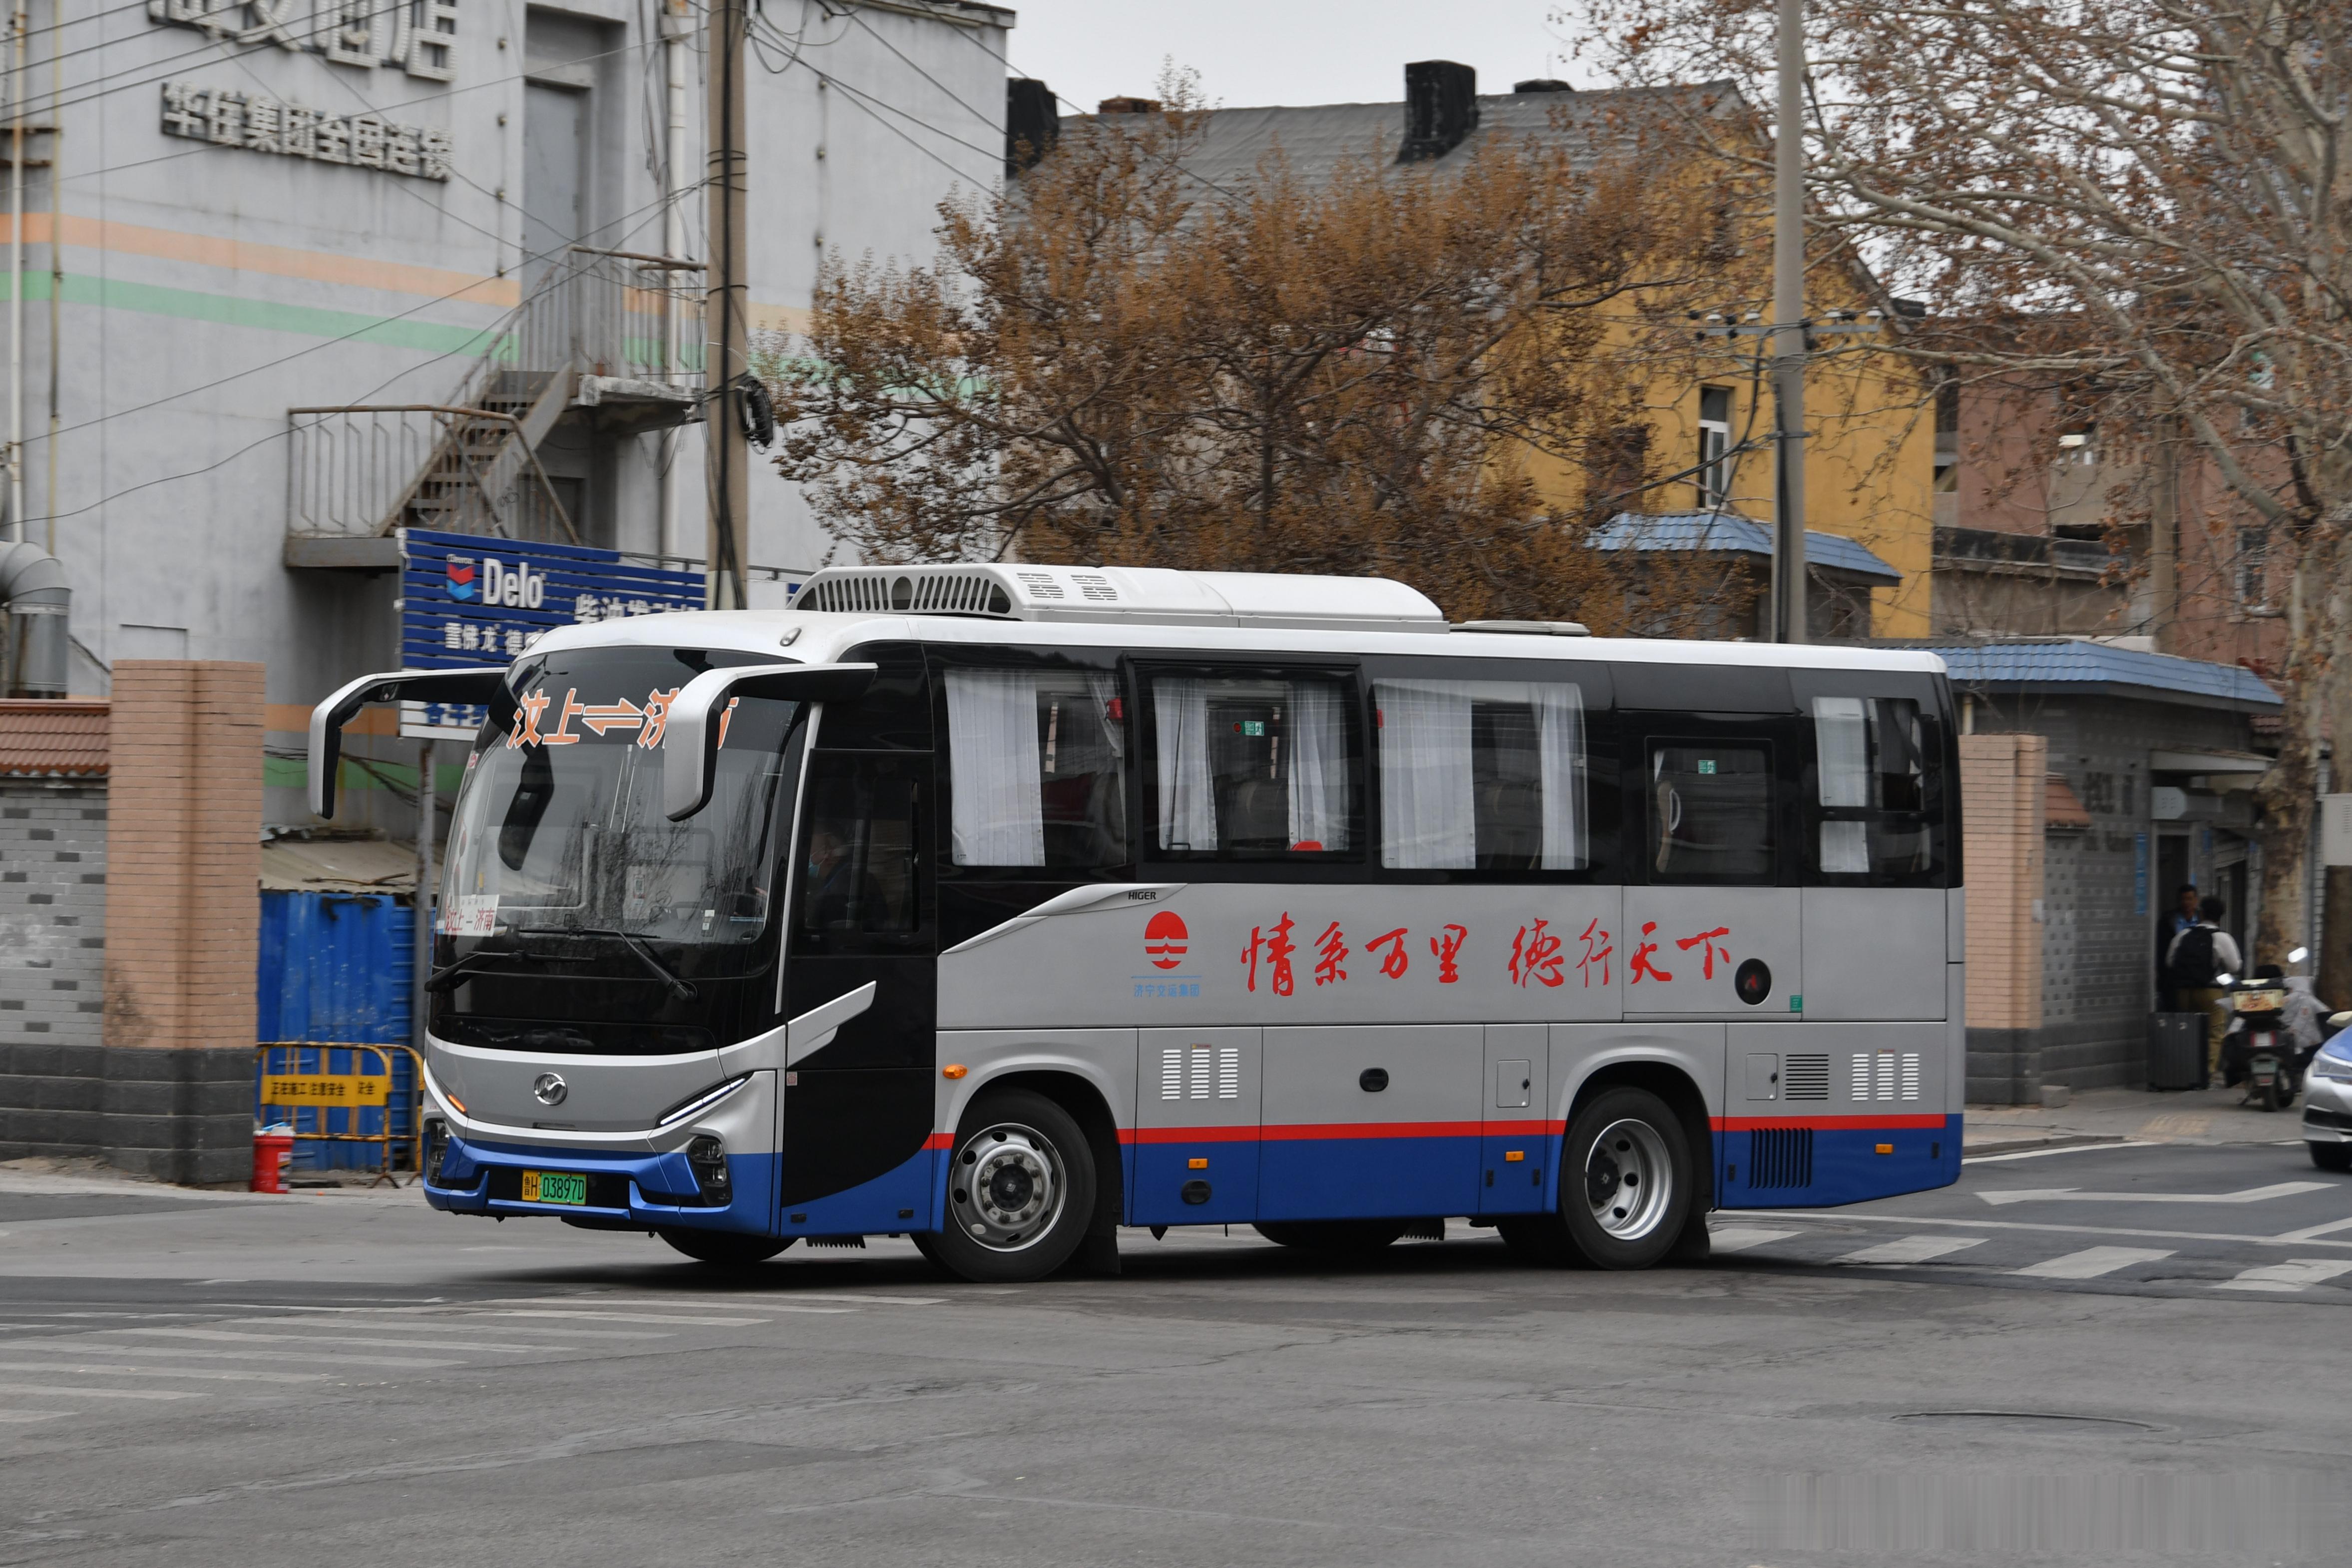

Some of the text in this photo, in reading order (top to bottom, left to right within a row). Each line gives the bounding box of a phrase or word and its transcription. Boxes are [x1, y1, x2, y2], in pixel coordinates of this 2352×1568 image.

[483, 558, 543, 608] Delo
[1128, 891, 1157, 900] HIGER
[1241, 911, 1730, 996] 情系万里 德行天下
[1134, 984, 1200, 997] 济宁交运集团
